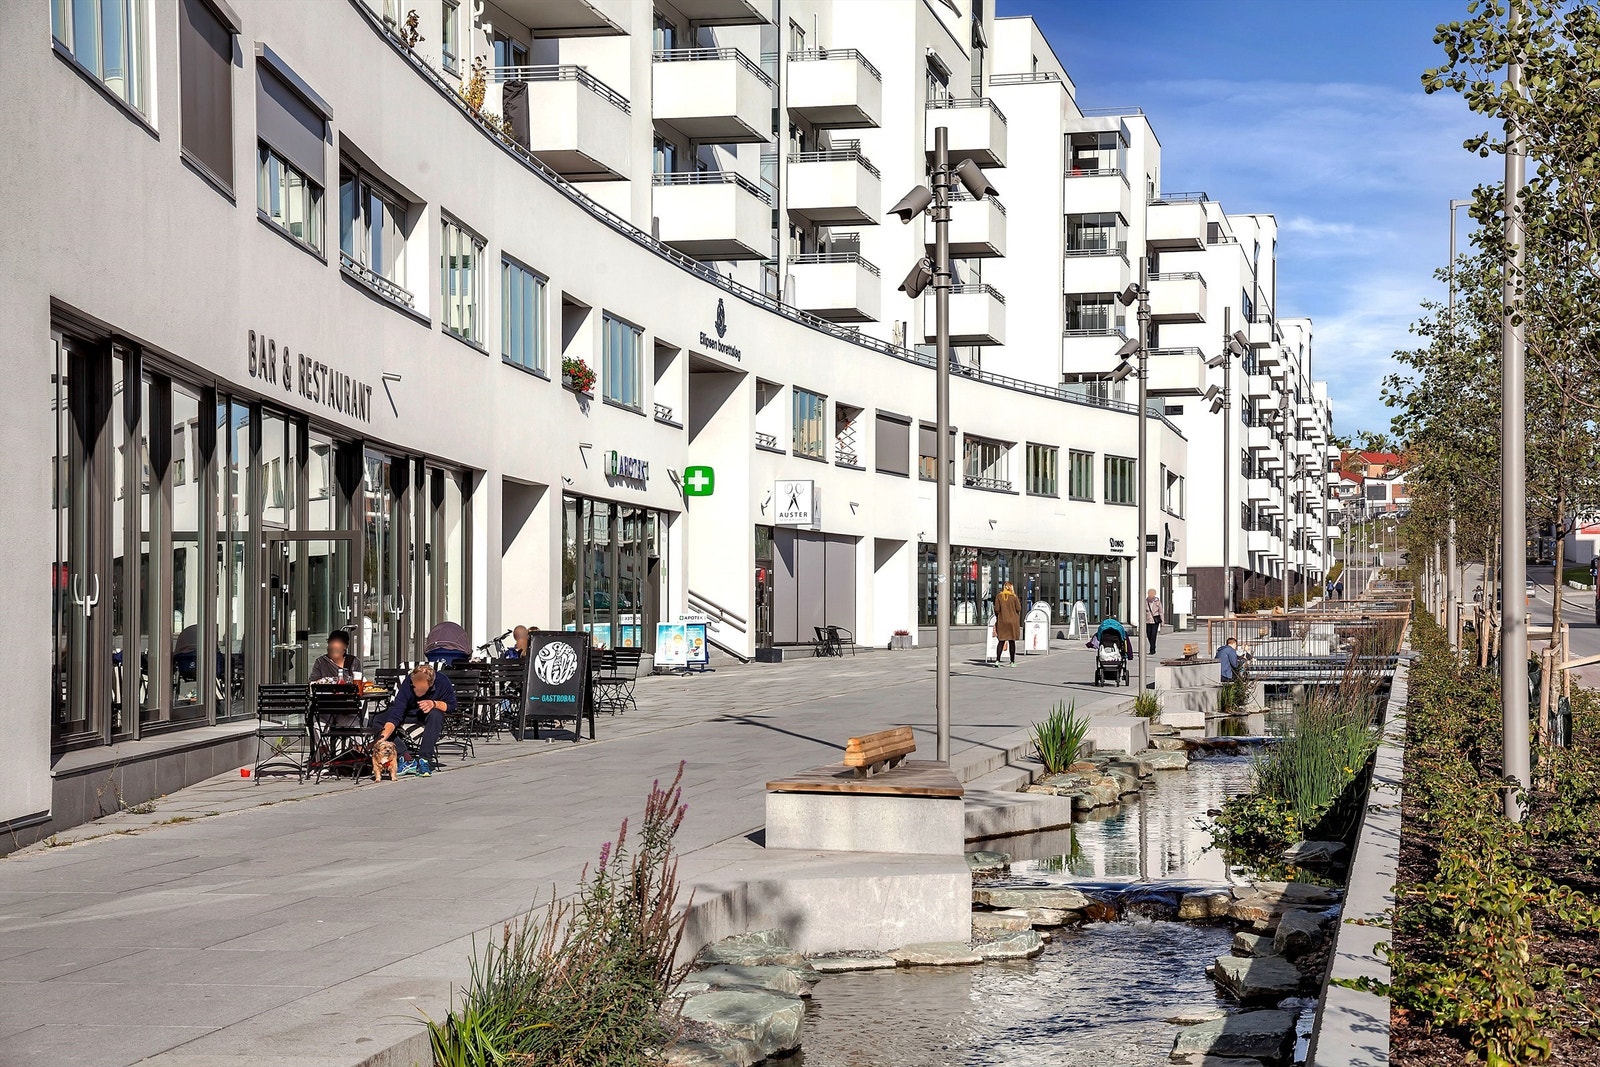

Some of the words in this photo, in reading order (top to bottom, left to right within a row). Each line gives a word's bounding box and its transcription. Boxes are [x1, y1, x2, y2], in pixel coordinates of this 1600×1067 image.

[248, 329, 277, 386] BAR
[282, 346, 292, 393] &
[298, 353, 372, 424] RESTAURANT
[541, 694, 576, 703] GASTROBAR
